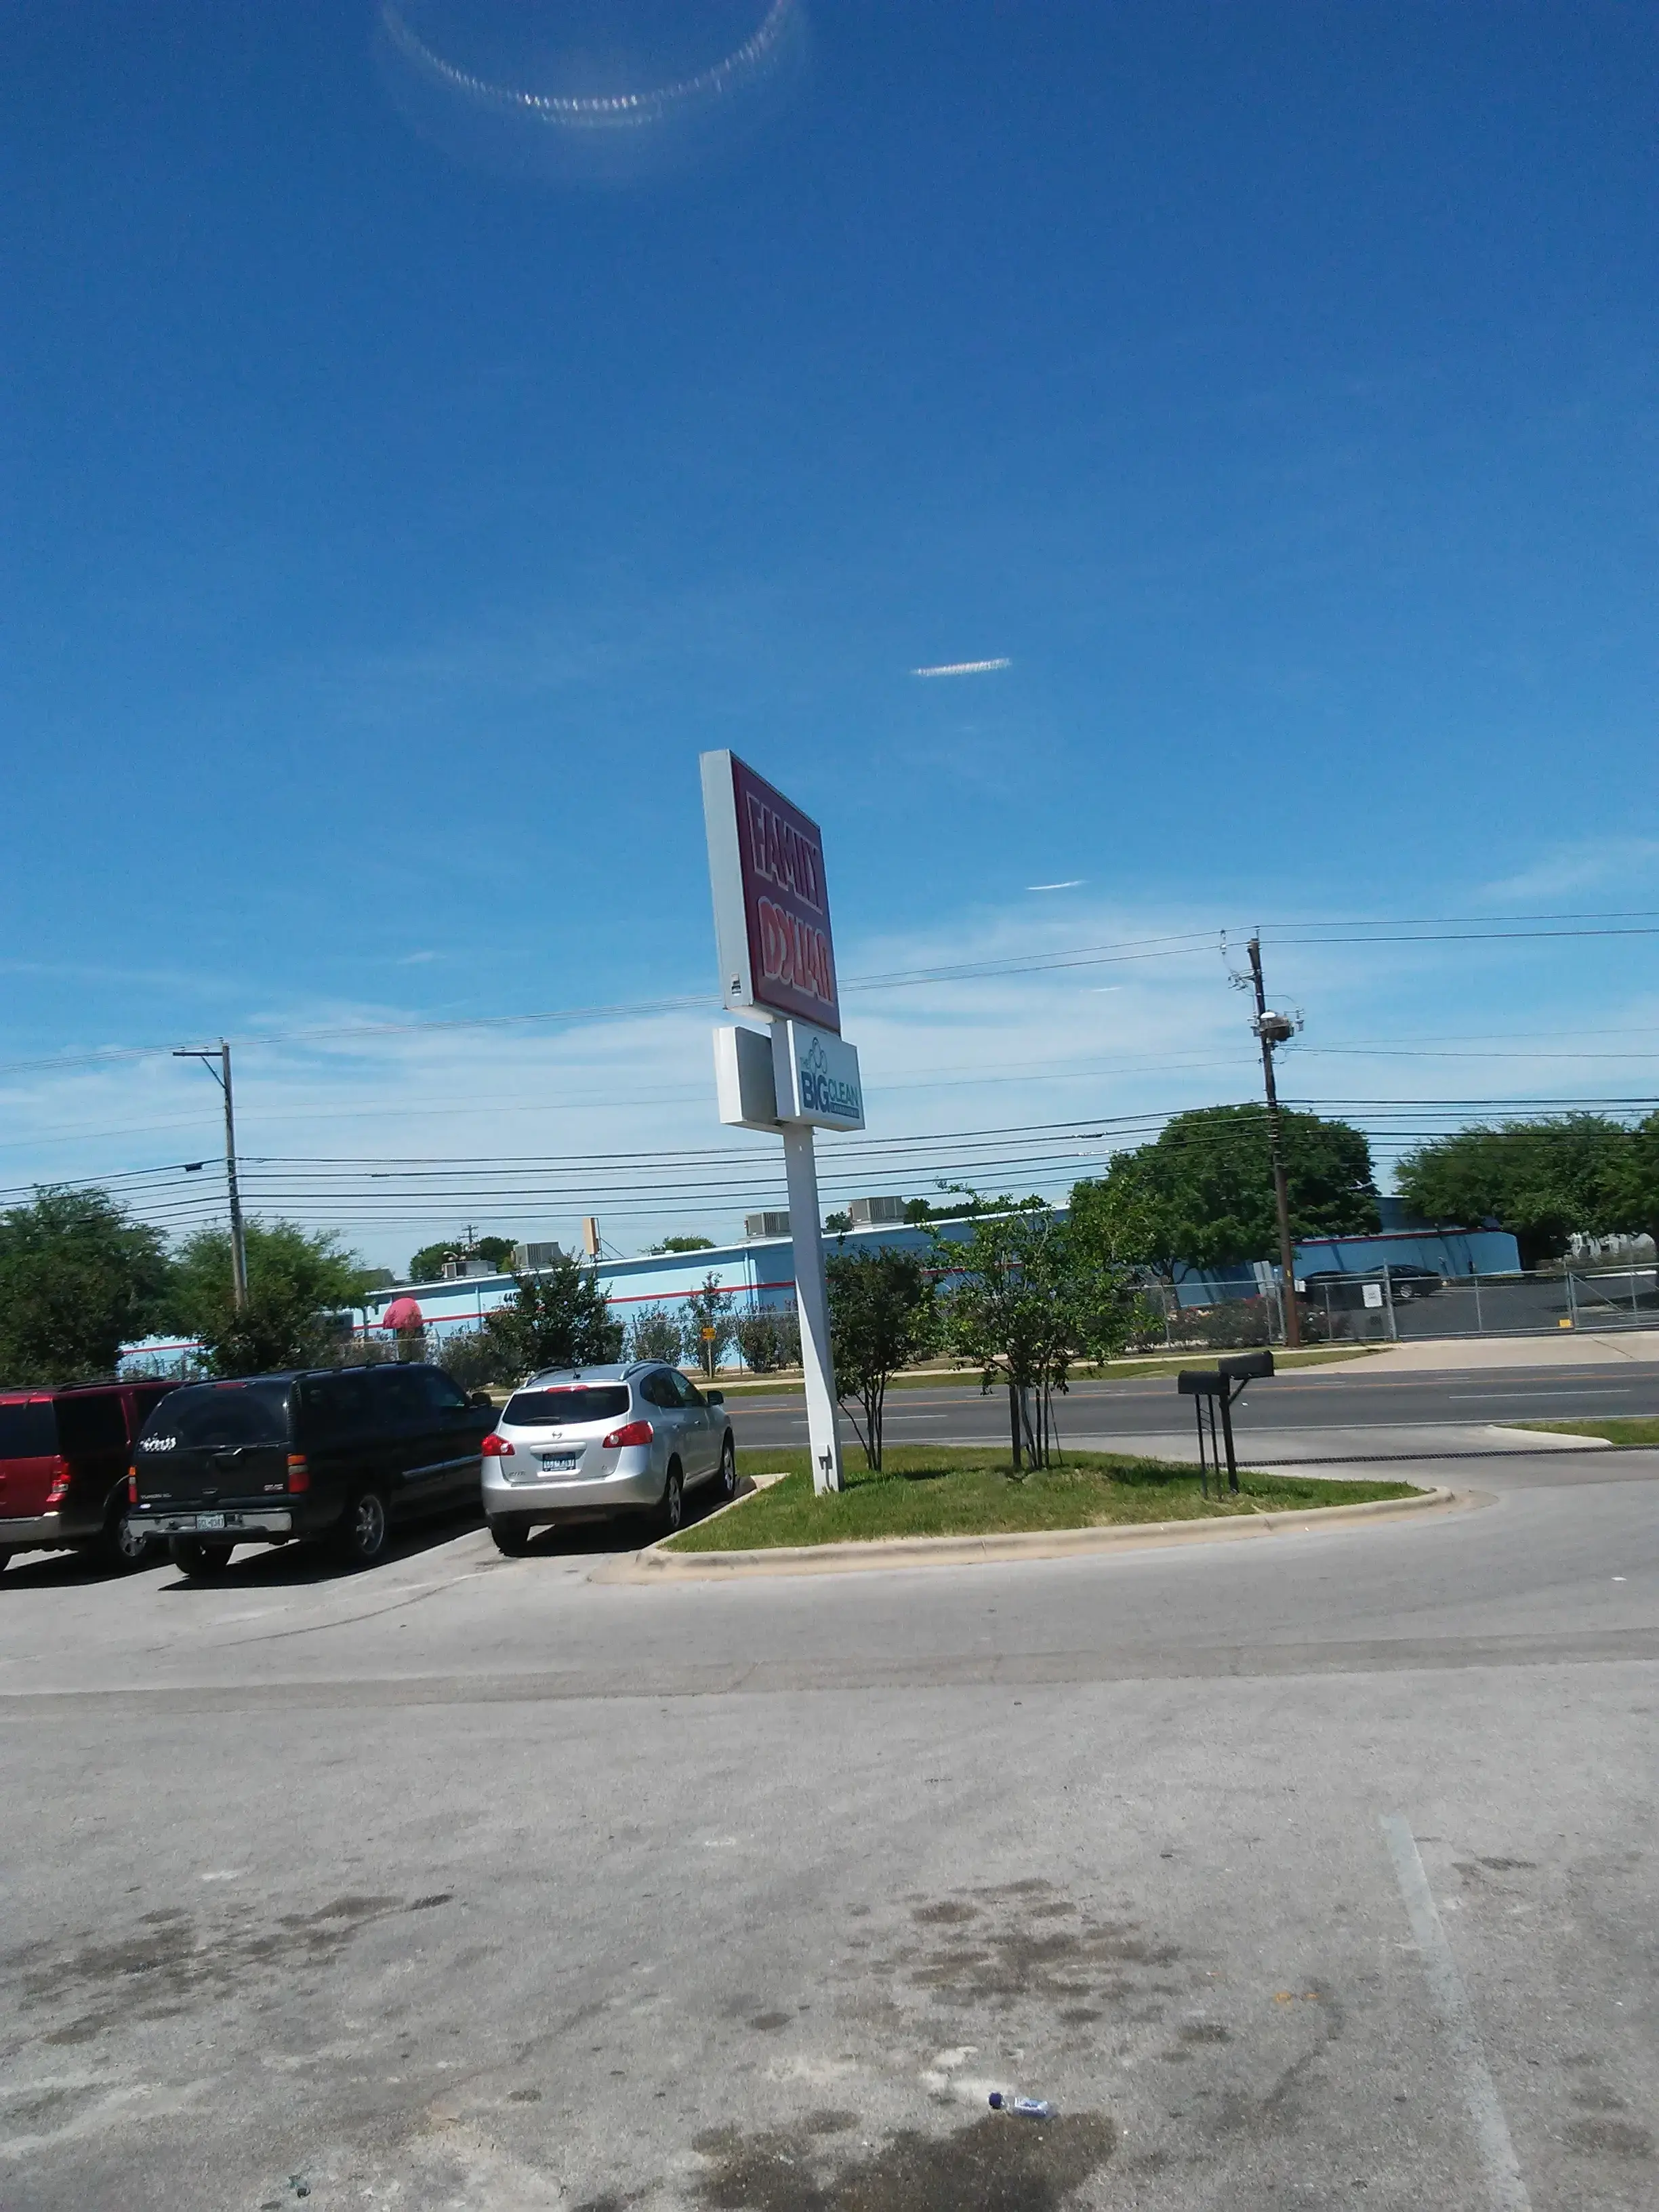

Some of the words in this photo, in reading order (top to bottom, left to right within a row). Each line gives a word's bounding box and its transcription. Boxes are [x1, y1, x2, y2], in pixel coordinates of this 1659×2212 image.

[758, 896, 834, 1006] DOLLAR
[801, 1071, 830, 1113] BIG
[828, 1079, 859, 1107] CLEAN
